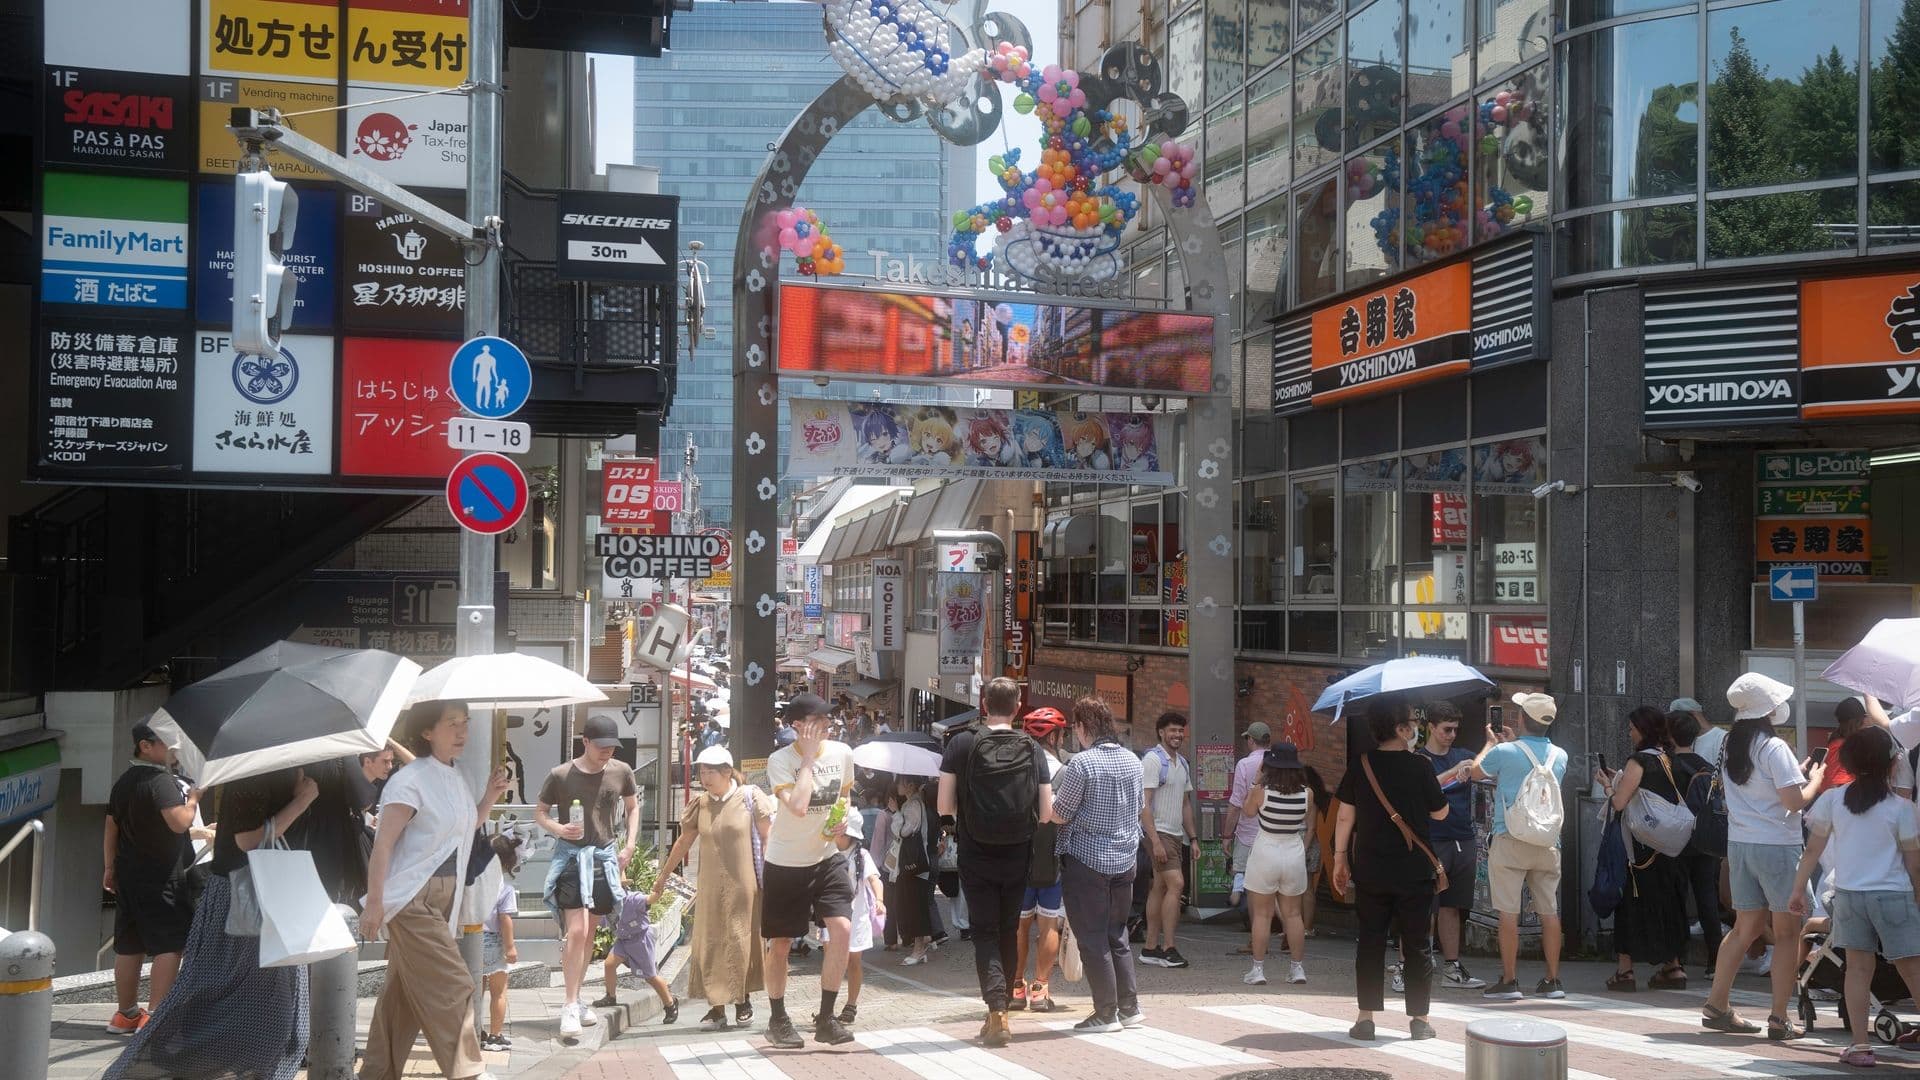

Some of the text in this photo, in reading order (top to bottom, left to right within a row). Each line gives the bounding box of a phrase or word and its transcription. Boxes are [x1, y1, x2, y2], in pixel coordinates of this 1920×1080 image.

[52, 70, 79, 87] 1F
[206, 81, 233, 98] 1F
[242, 87, 335, 103] Vending machine
[64, 90, 173, 129] SASAKI
[73, 130, 165, 150] PAS à PAS
[422, 134, 468, 149] Tax-fre
[73, 145, 165, 159] HARAJUKU SASAKI
[441, 151, 466, 163] Sho
[352, 195, 375, 213] BF
[562, 213, 672, 230] SKECHERS
[49, 226, 183, 255] FamilyMart
[591, 245, 628, 259] 30m
[358, 263, 465, 278] HOSHINO COFFEE
[867, 249, 1131, 301] Takeshita Street
[74, 278, 158, 303] 酒 たばこ
[1339, 286, 1417, 356] 吉野家
[50, 332, 179, 355] 防災備蓄倉庫
[201, 337, 230, 353] BF
[1474, 322, 1534, 351] YOSHINOYA
[50, 353, 178, 374] (災害時避難場所)
[1340, 347, 1417, 386] YOSHINOYA
[50, 372, 177, 390] Emergency Evacuation Area
[356, 379, 457, 402] はらじゅく
[1276, 380, 1312, 401] YOSHINOYA
[1649, 378, 1792, 405] YOSHINOYA
[234, 410, 297, 428] 海鮮処
[608, 467, 650, 480] クスリ
[606, 484, 651, 504] OS
[606, 508, 652, 519] ドラッグ
[600, 535, 720, 557] HOSHINO
[1770, 526, 1865, 553] 吉野家
[610, 556, 711, 577] COFFEE
[876, 565, 901, 577] NOA
[347, 596, 389, 605] Baggage
[351, 605, 389, 615] Storage
[883, 581, 893, 647] COFFEE
[353, 615, 389, 624] Service
[1030, 679, 1072, 699] WOLFGANG
[795, 764, 841, 777] YEMITE
